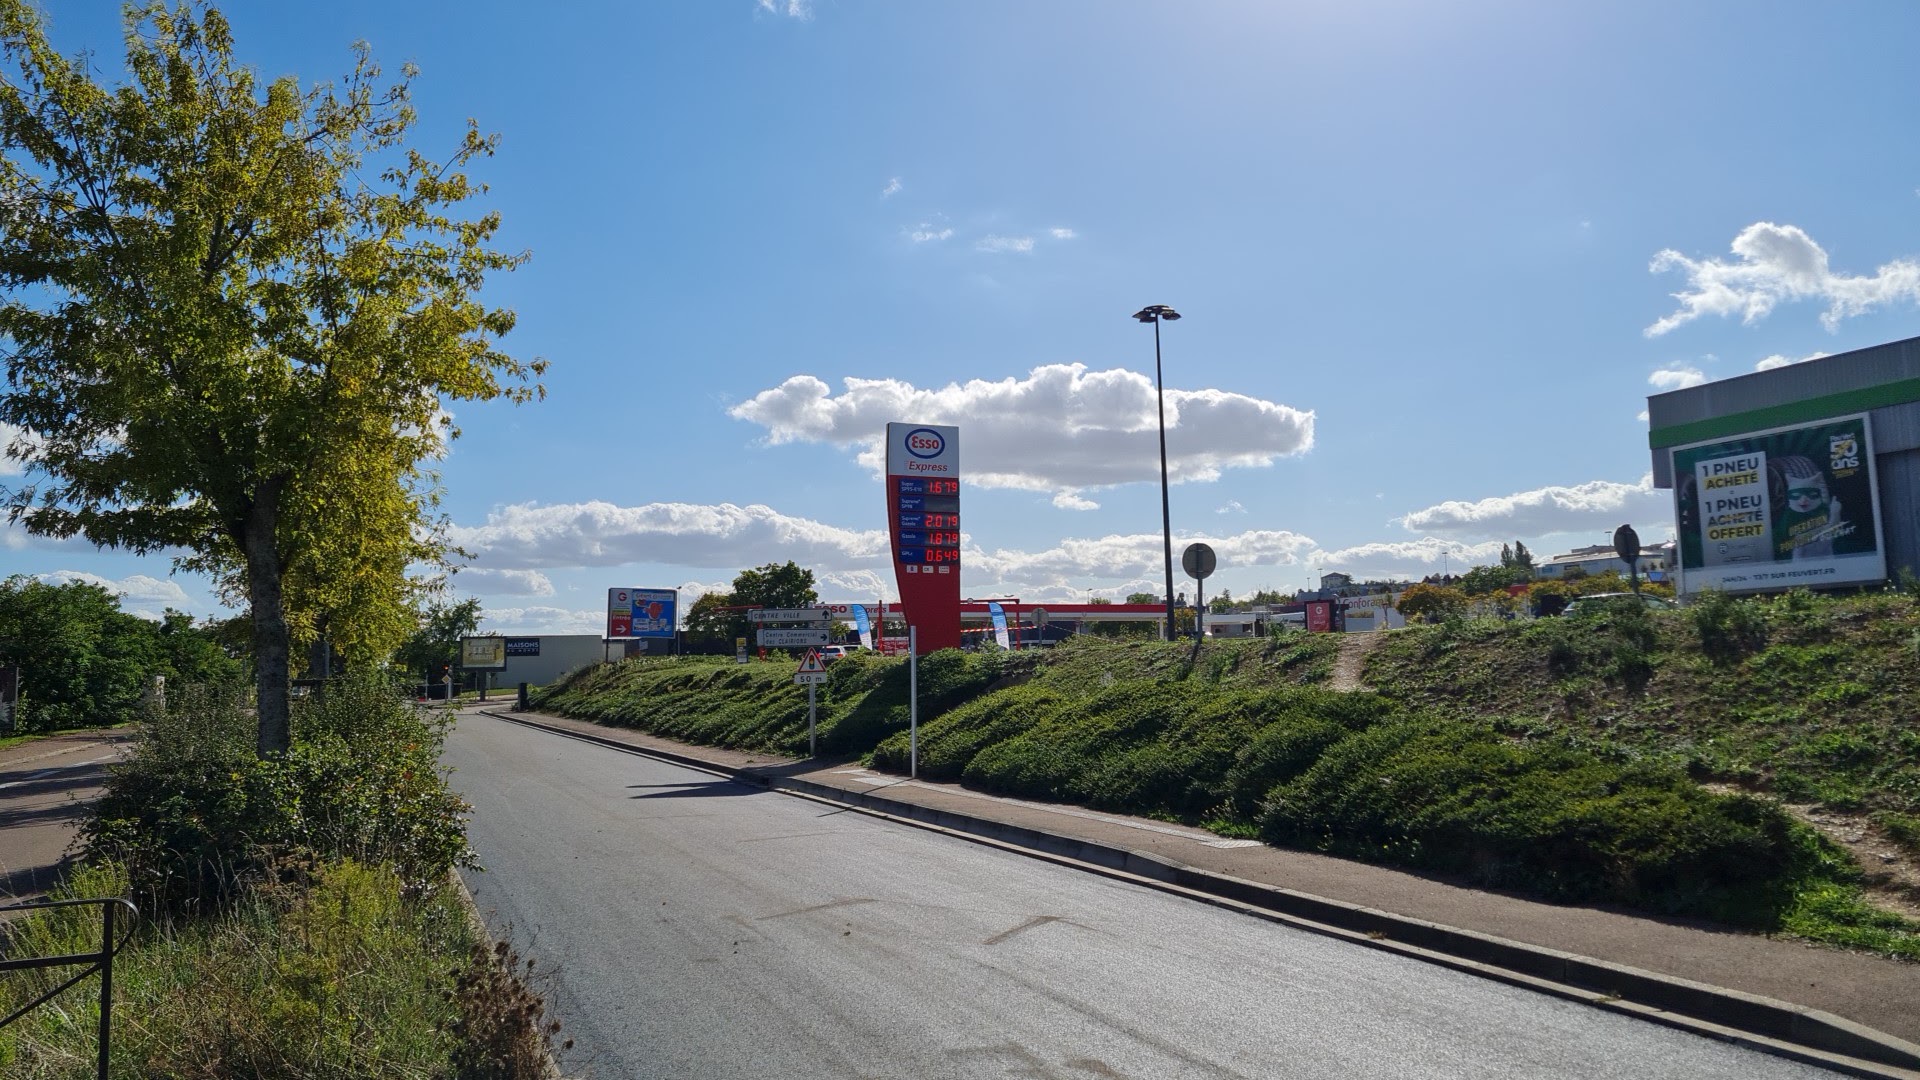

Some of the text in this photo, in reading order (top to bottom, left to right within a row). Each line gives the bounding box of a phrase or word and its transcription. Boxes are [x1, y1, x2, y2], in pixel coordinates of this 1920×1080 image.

[1830, 440, 1858, 460] 50
[908, 461, 948, 472] Express
[1702, 457, 1759, 477] 1 PNEU
[1831, 456, 1860, 470] ans
[1706, 471, 1758, 490] ACHETÉ
[1706, 494, 1762, 513] 1 PNEU
[1708, 508, 1764, 526] ACHETÉ
[1710, 524, 1763, 540] OFFERT
